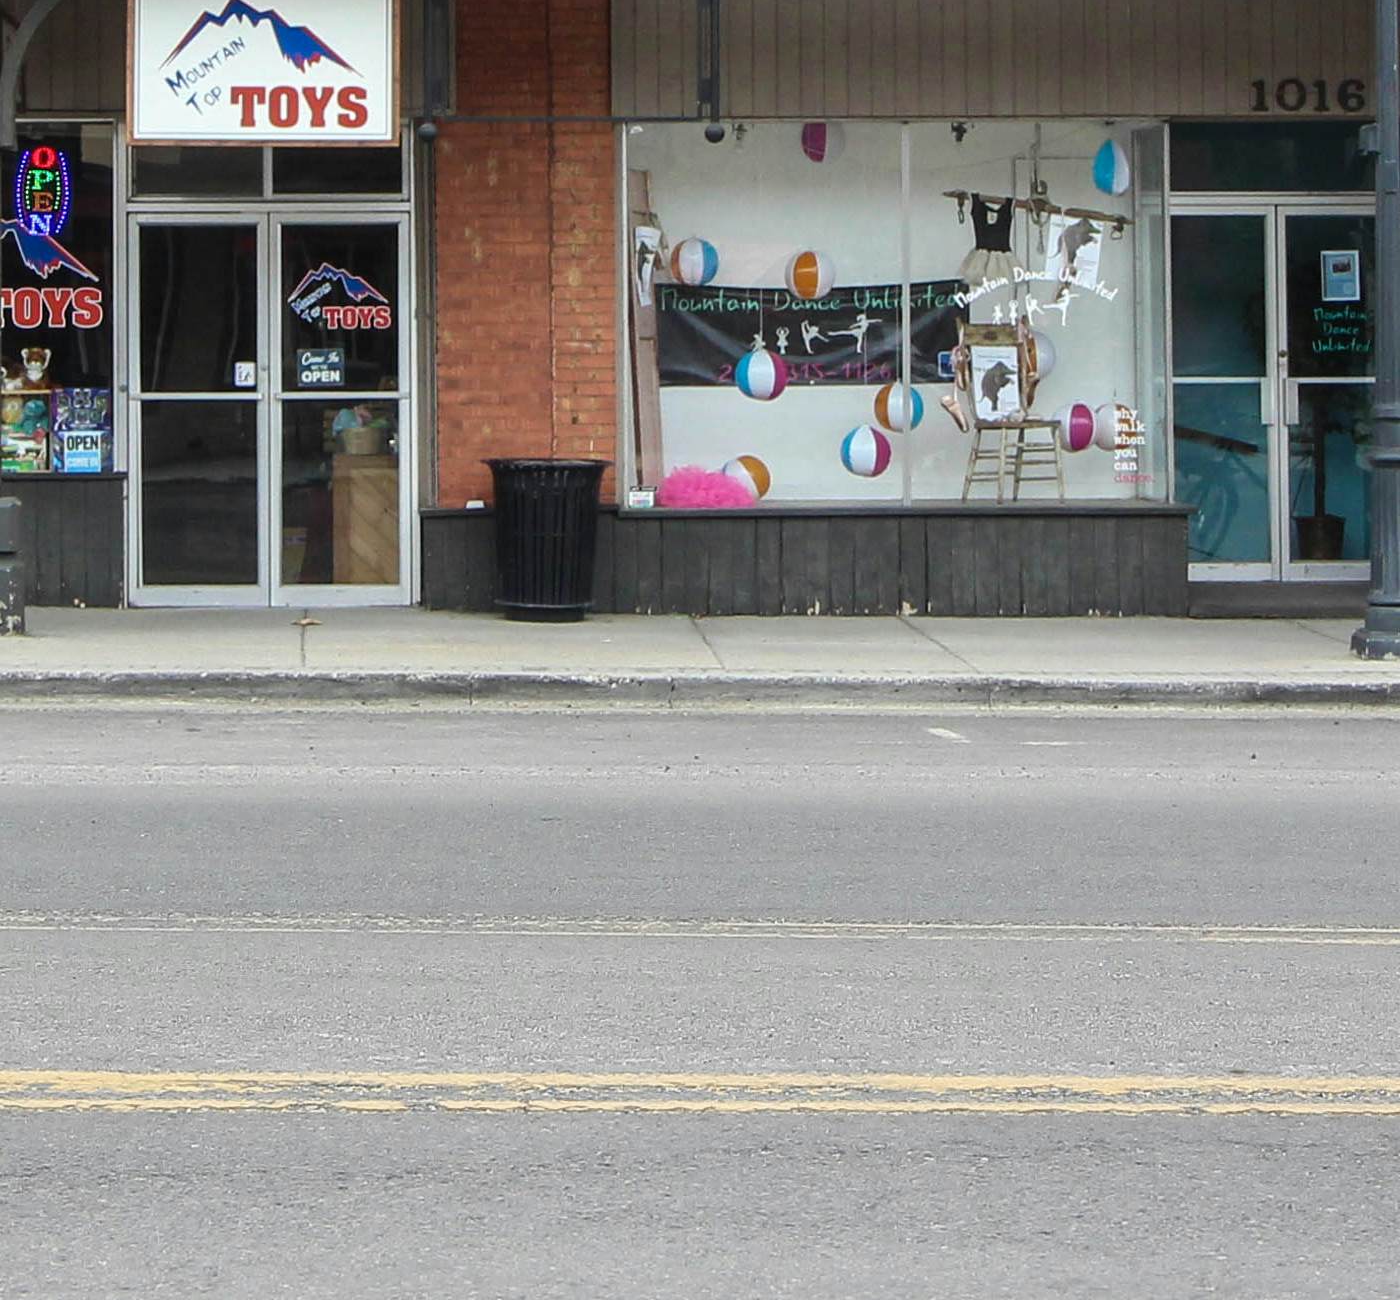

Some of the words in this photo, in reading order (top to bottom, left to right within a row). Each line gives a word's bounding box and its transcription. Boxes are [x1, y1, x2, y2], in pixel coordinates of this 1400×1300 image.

[1251, 78, 1366, 112] 1016
[230, 86, 369, 128] TOYS
[28, 147, 58, 236] OPEN
[661, 291, 760, 311] Mountain
[773, 291, 841, 311] Dance
[953, 277, 1008, 308] Mountain
[322, 305, 392, 330] TOYS
[301, 370, 341, 383] OPEN
[66, 435, 98, 451] OPEN
[1113, 432, 1146, 445] when
[1113, 448, 1138, 460] you
[1113, 461, 1138, 471] can
